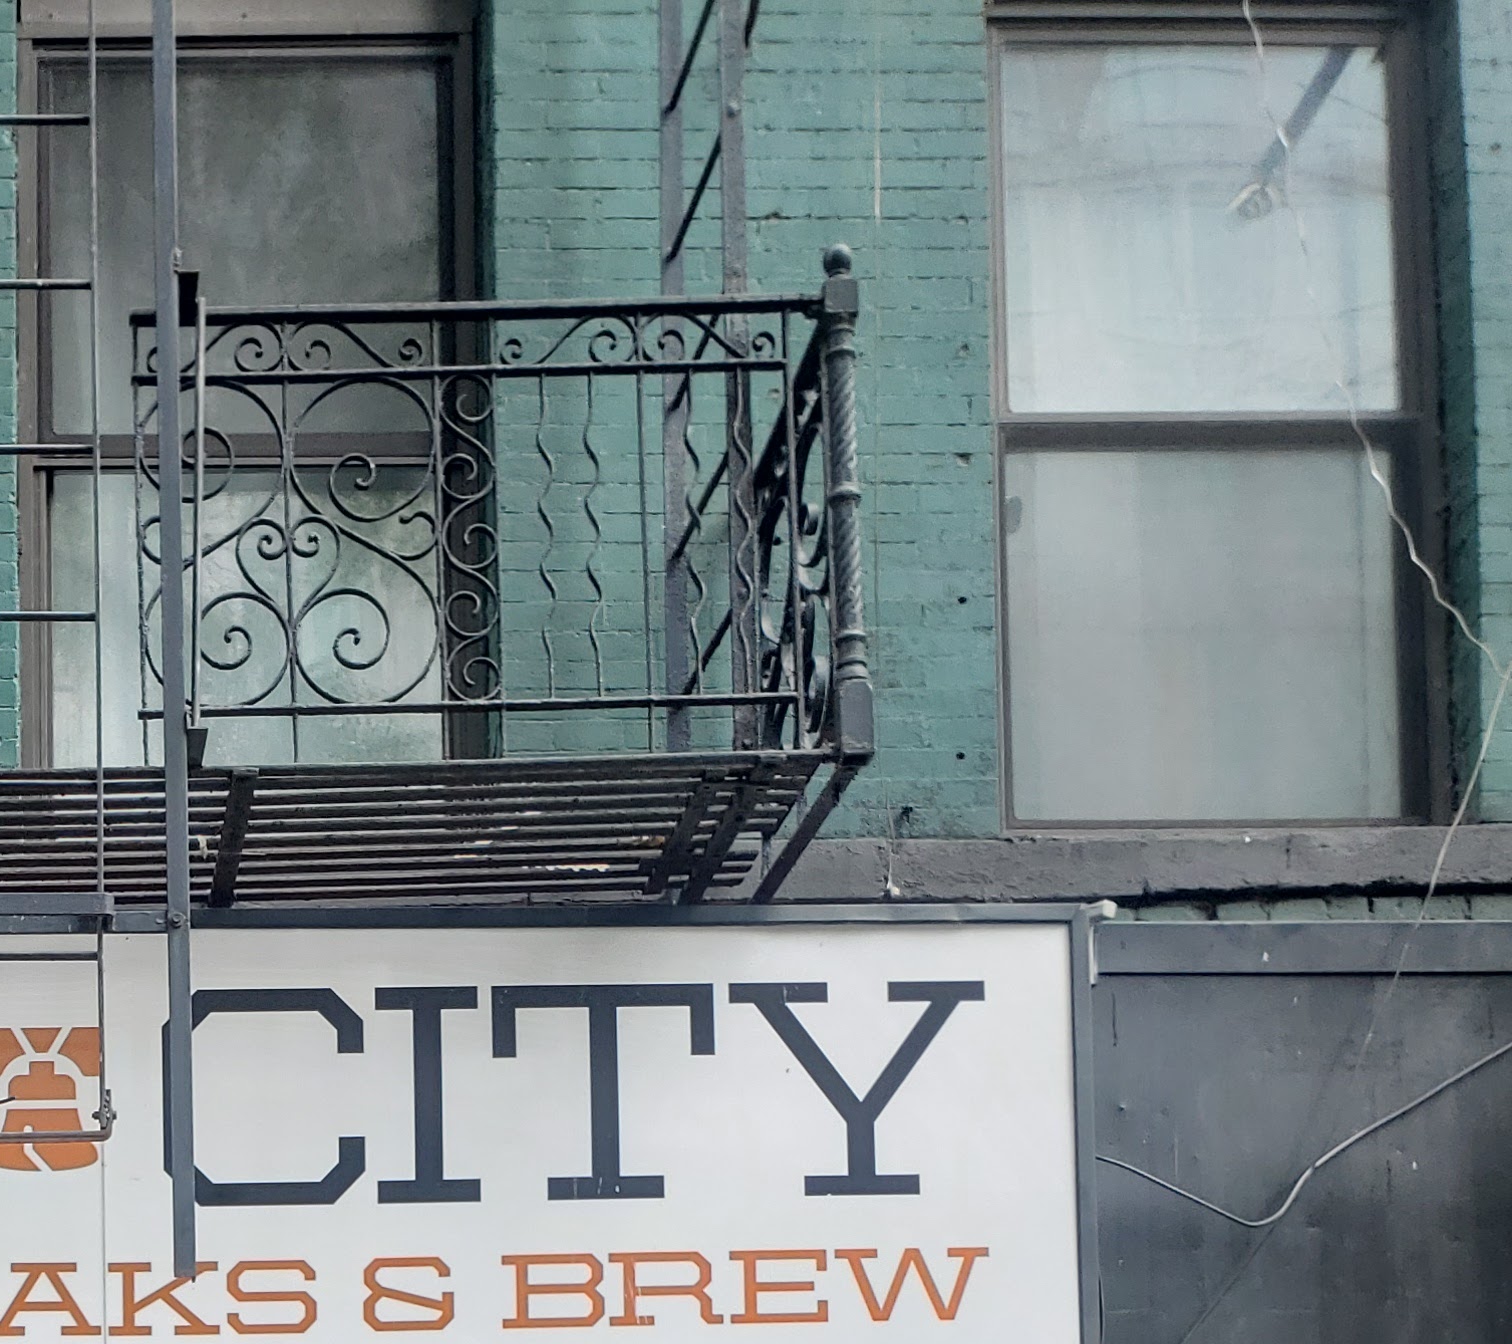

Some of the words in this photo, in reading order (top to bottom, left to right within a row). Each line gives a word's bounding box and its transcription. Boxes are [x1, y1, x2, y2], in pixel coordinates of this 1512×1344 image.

[163, 980, 985, 1206] CITY
[363, 1256, 455, 1332] &
[500, 1246, 990, 1329] BREW
